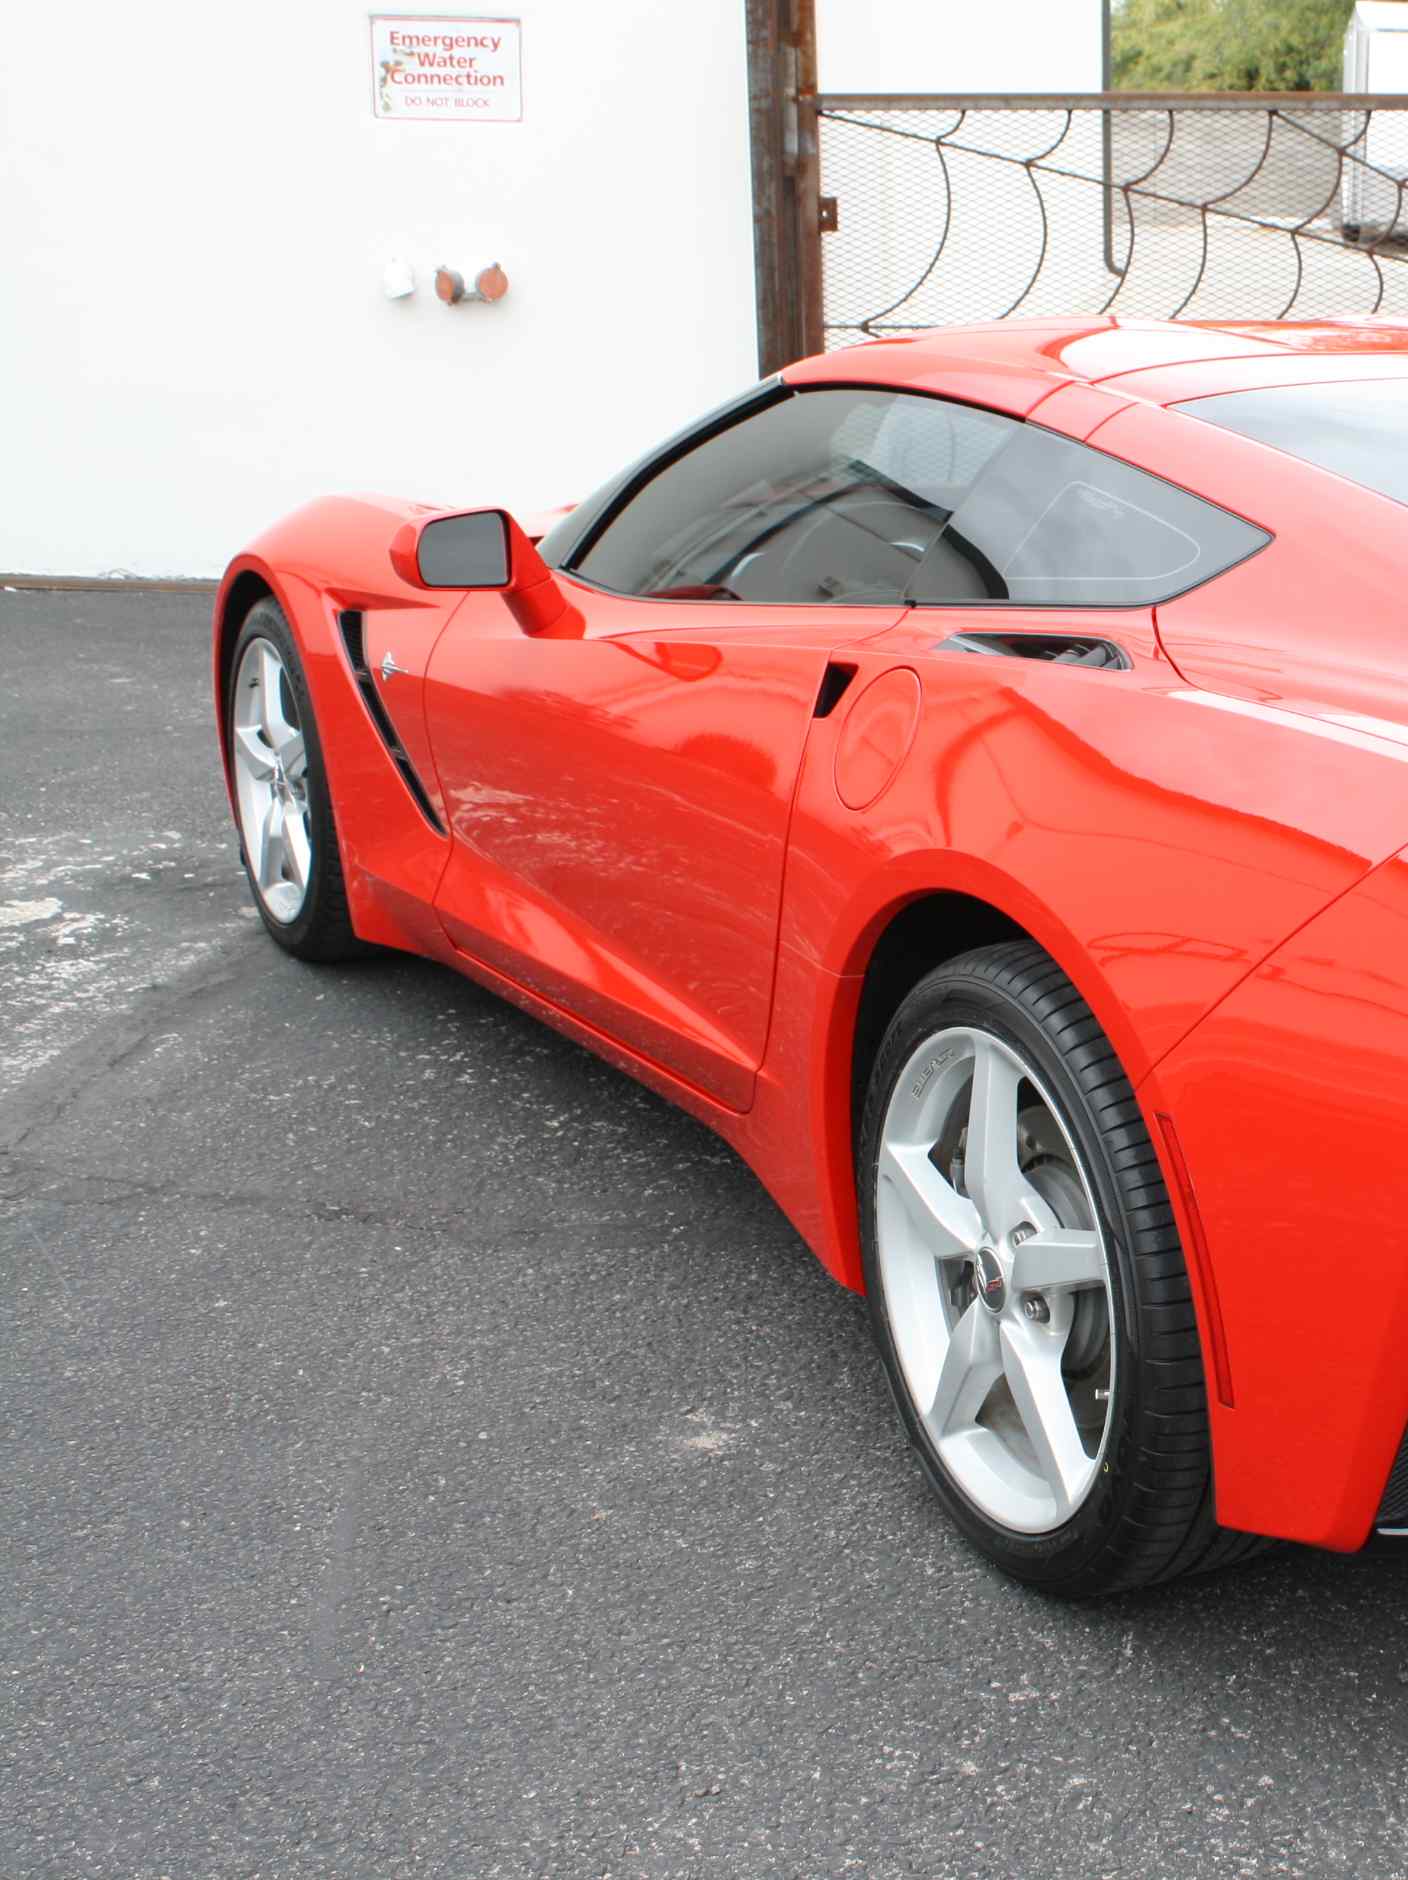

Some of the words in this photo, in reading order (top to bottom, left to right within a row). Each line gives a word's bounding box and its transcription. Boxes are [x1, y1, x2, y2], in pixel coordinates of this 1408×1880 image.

[389, 31, 502, 52] Emergency
[416, 52, 477, 69] Water
[389, 69, 505, 87] Connection
[404, 95, 423, 106] DO
[426, 96, 450, 107] NOT
[454, 97, 491, 108] BLOCK
